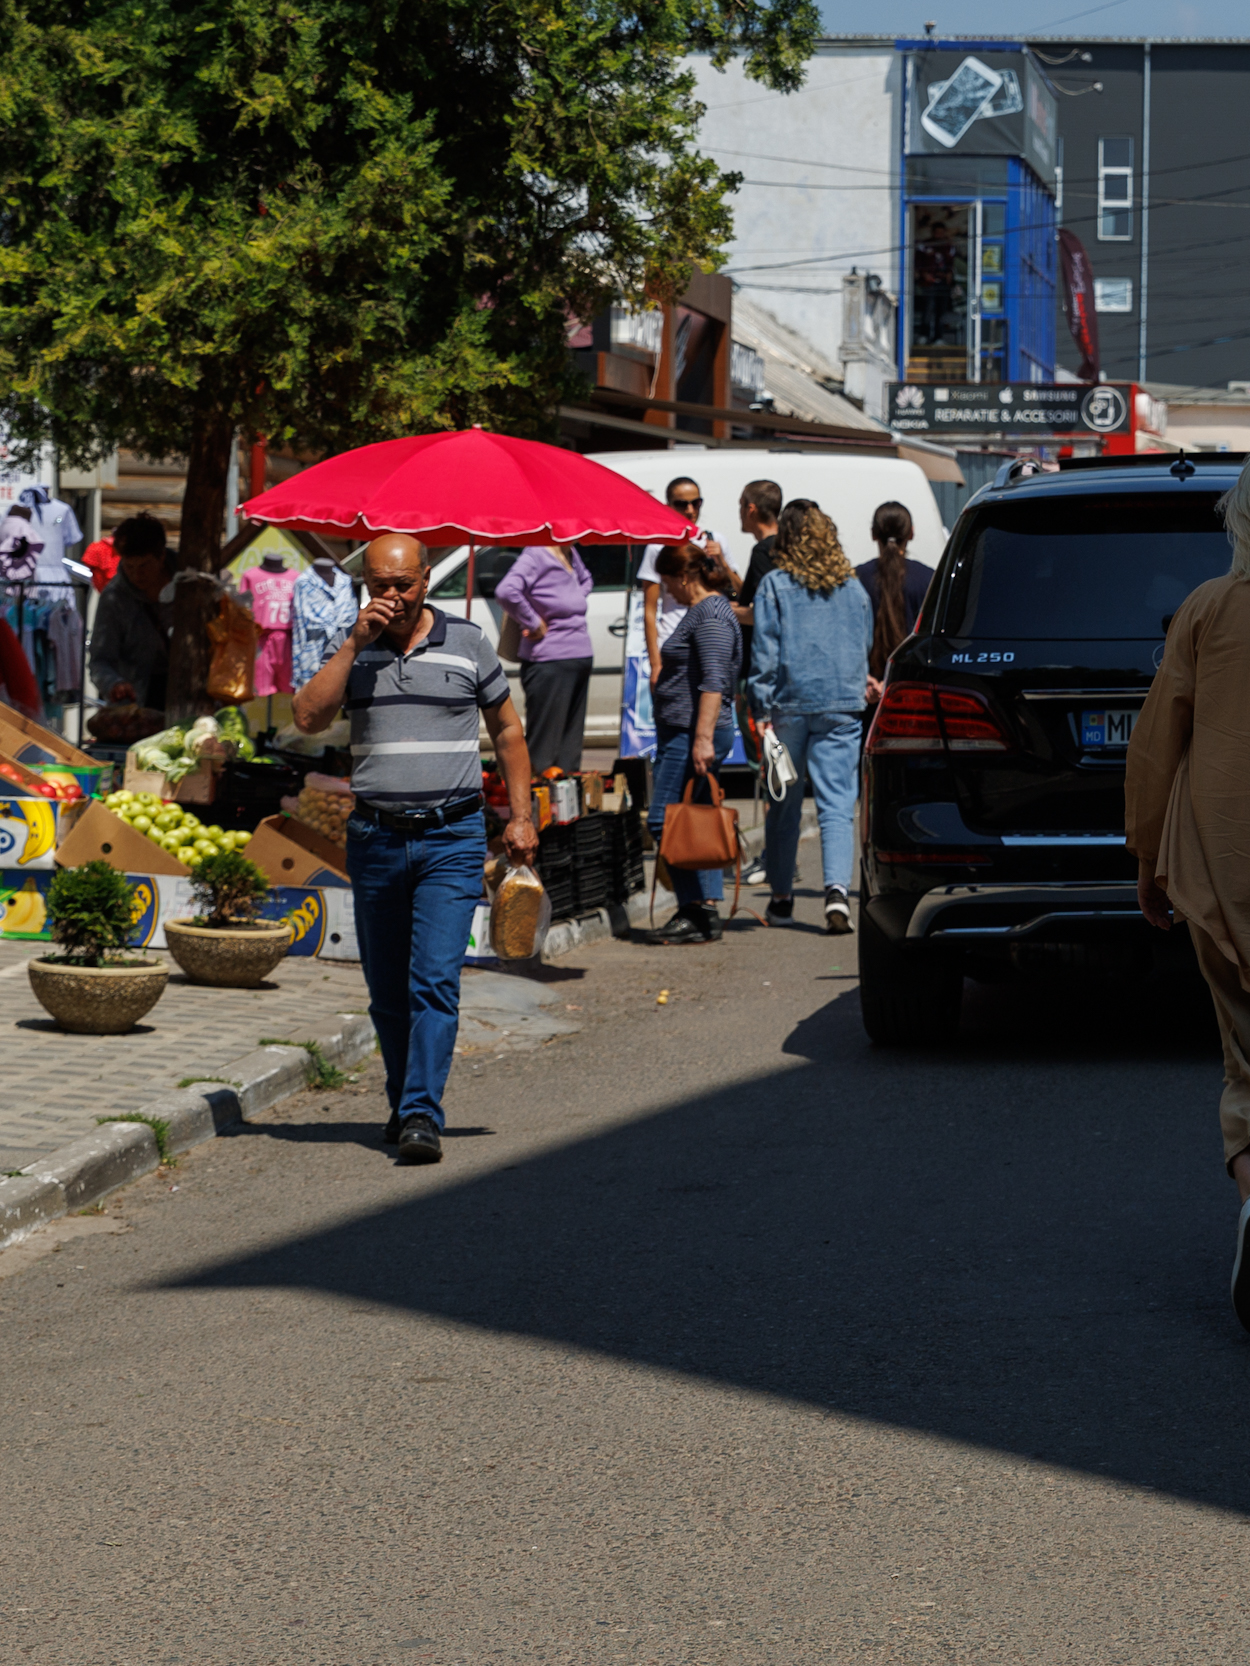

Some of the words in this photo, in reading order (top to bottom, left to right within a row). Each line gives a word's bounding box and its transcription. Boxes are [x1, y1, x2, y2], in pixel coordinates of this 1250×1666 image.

[951, 390, 988, 401] Xiaomi
[1023, 390, 1076, 401] SAMSUNG
[935, 408, 999, 422] REPARATIE
[1001, 410, 1011, 422] &
[1013, 409, 1077, 423] ACCESORII
[891, 419, 928, 429] NOKIA
[269, 601, 291, 624] 75
[952, 653, 973, 663] ML
[977, 652, 1015, 663] 250
[1086, 731, 1101, 741] MD
